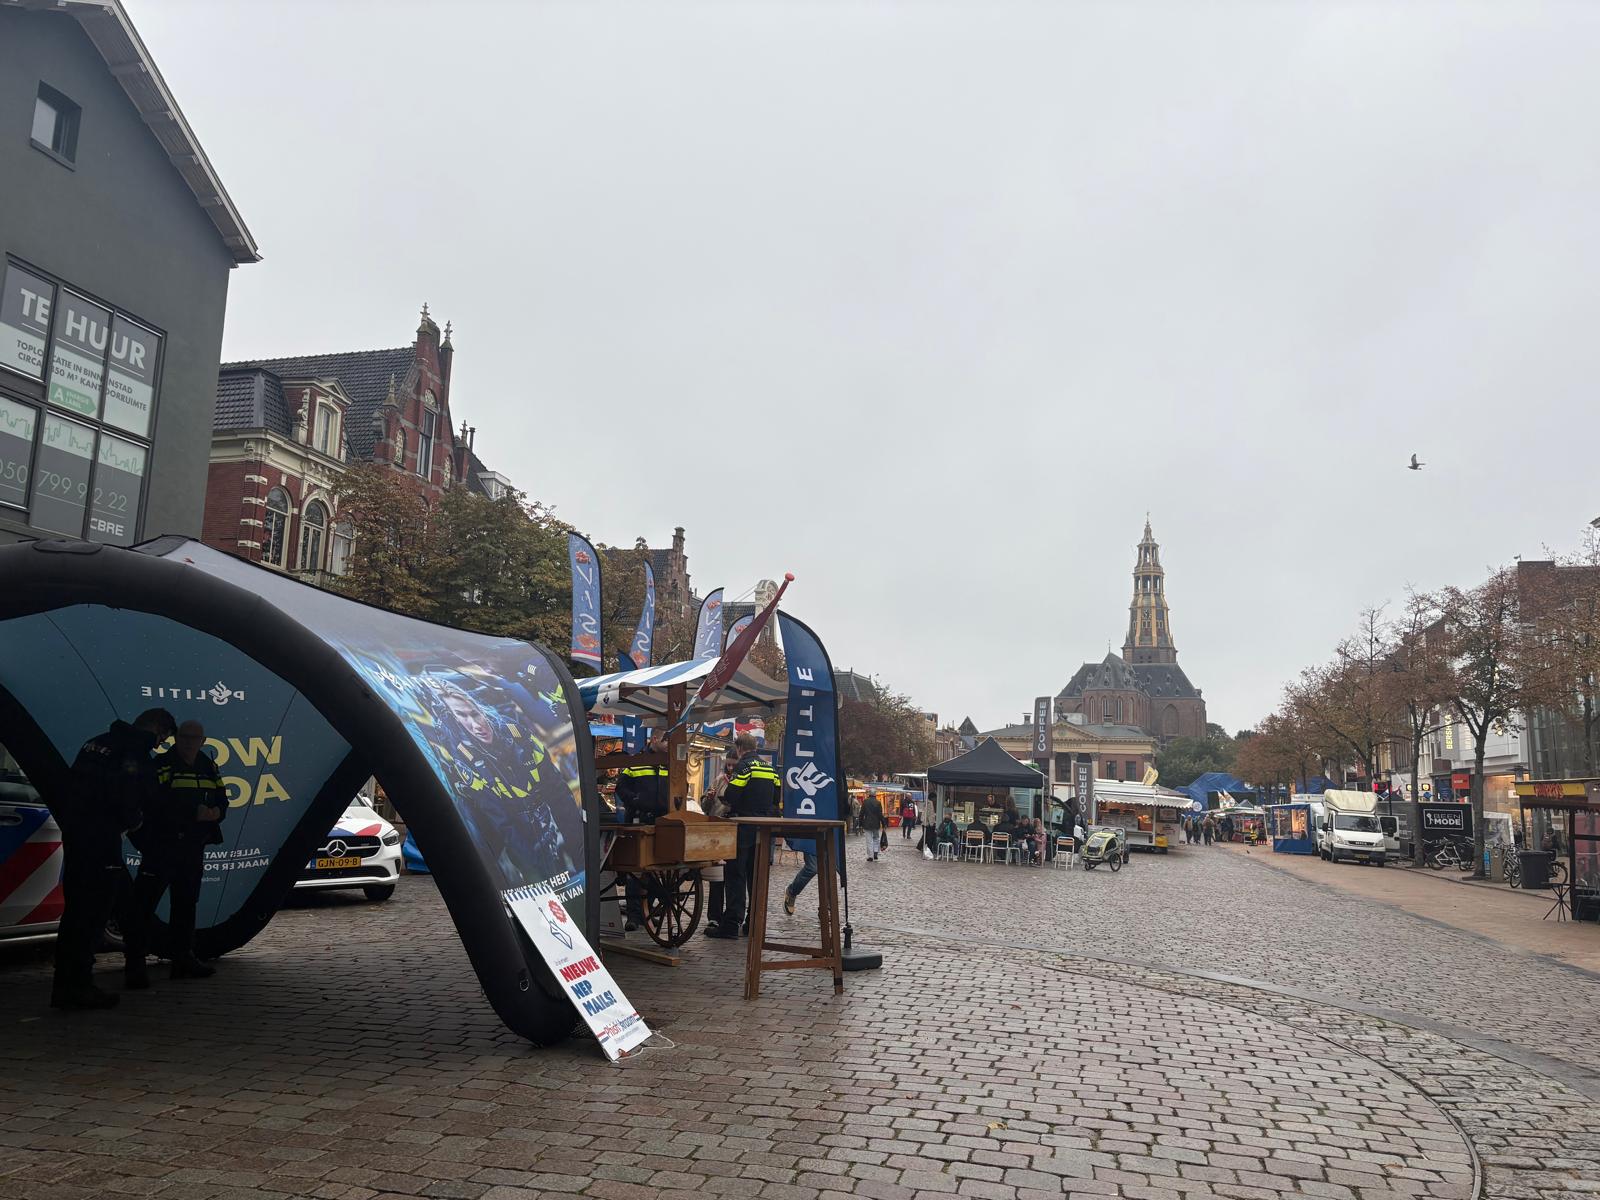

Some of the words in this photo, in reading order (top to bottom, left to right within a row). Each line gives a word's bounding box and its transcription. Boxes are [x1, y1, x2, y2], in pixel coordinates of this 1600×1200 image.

[20, 288, 50, 326] TE
[65, 308, 147, 370] HUUR
[18, 352, 42, 371] CIRCA
[73, 363, 82, 373] IN
[83, 368, 133, 394] BINNNSTAD
[38, 470, 72, 494] 799
[108, 492, 127, 512] 22
[90, 518, 124, 536] CBRE
[1038, 701, 1046, 751] COFFEE
[1445, 714, 1453, 750] BERSHKA
[1079, 767, 1087, 812] COFFEE
[318, 857, 358, 868] GJN-09-B
[550, 871, 571, 887] HEBT
[567, 885, 584, 899] VAN
[559, 955, 600, 982] NIEUWE
[570, 979, 593, 1000] NEP
[582, 990, 618, 1017] MAILS!
